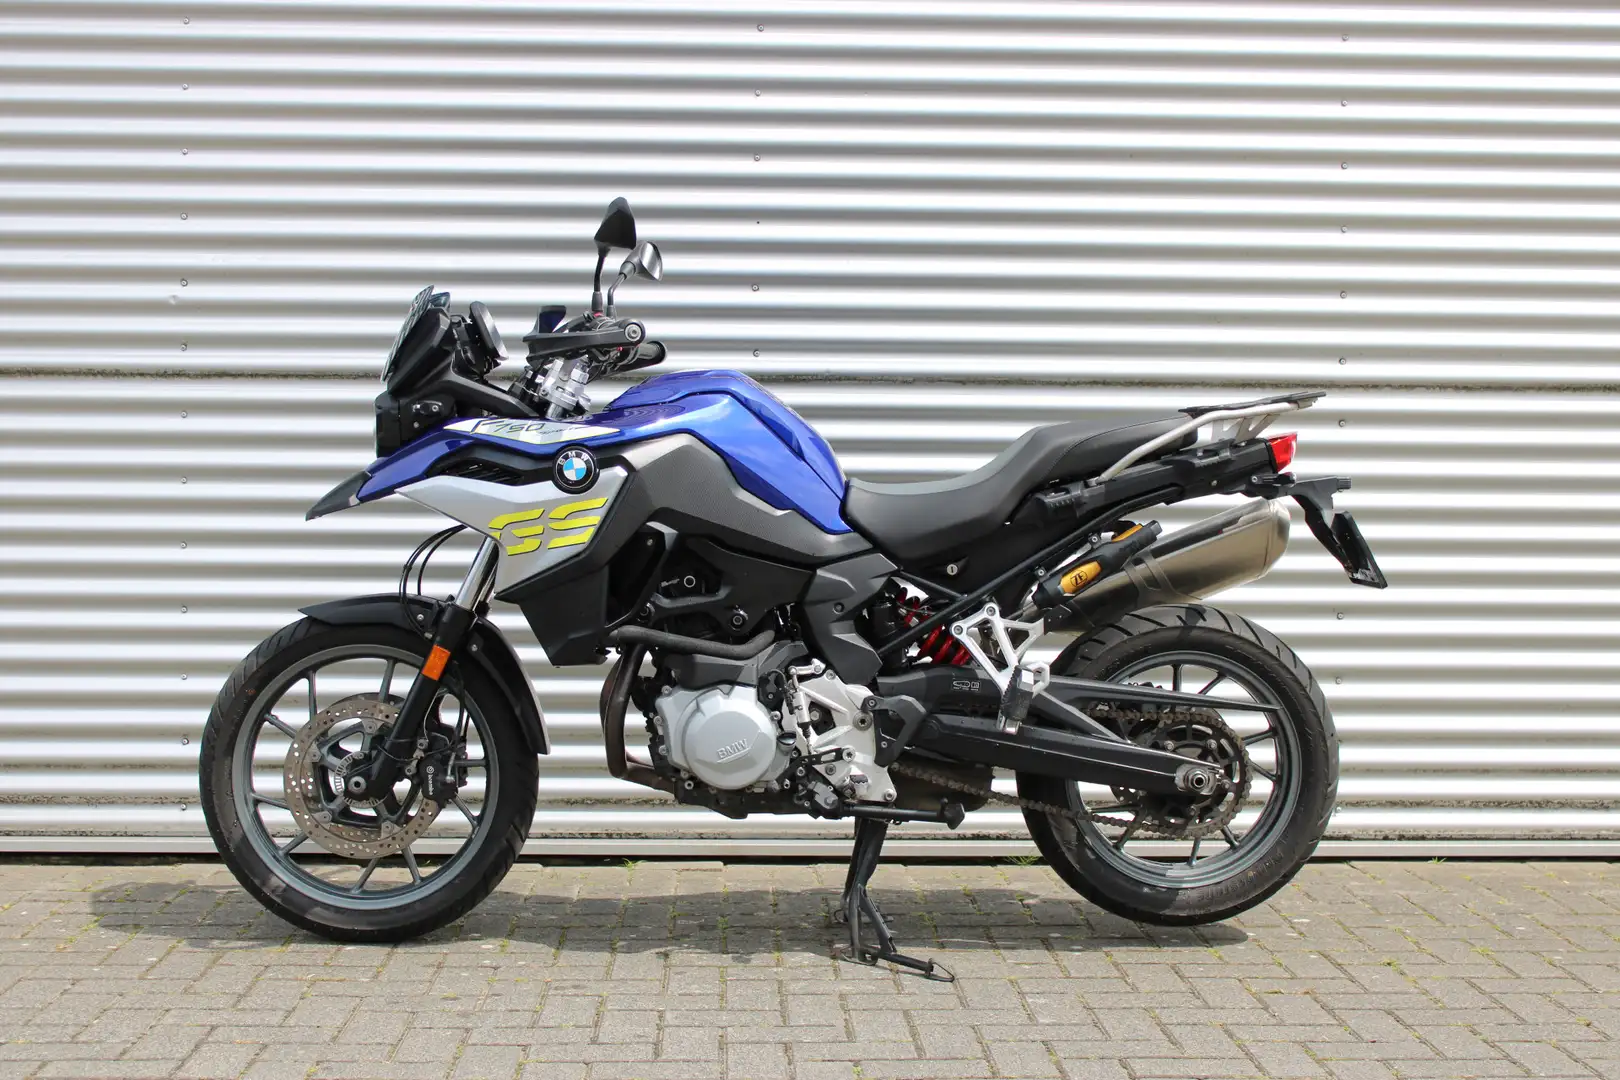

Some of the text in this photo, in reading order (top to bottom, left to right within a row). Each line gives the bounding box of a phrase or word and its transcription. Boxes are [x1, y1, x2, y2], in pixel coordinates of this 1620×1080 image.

[558, 450, 590, 465] BMW
[488, 497, 608, 556] GS
[1073, 572, 1086, 587] ZF
[716, 738, 748, 760] BMW
